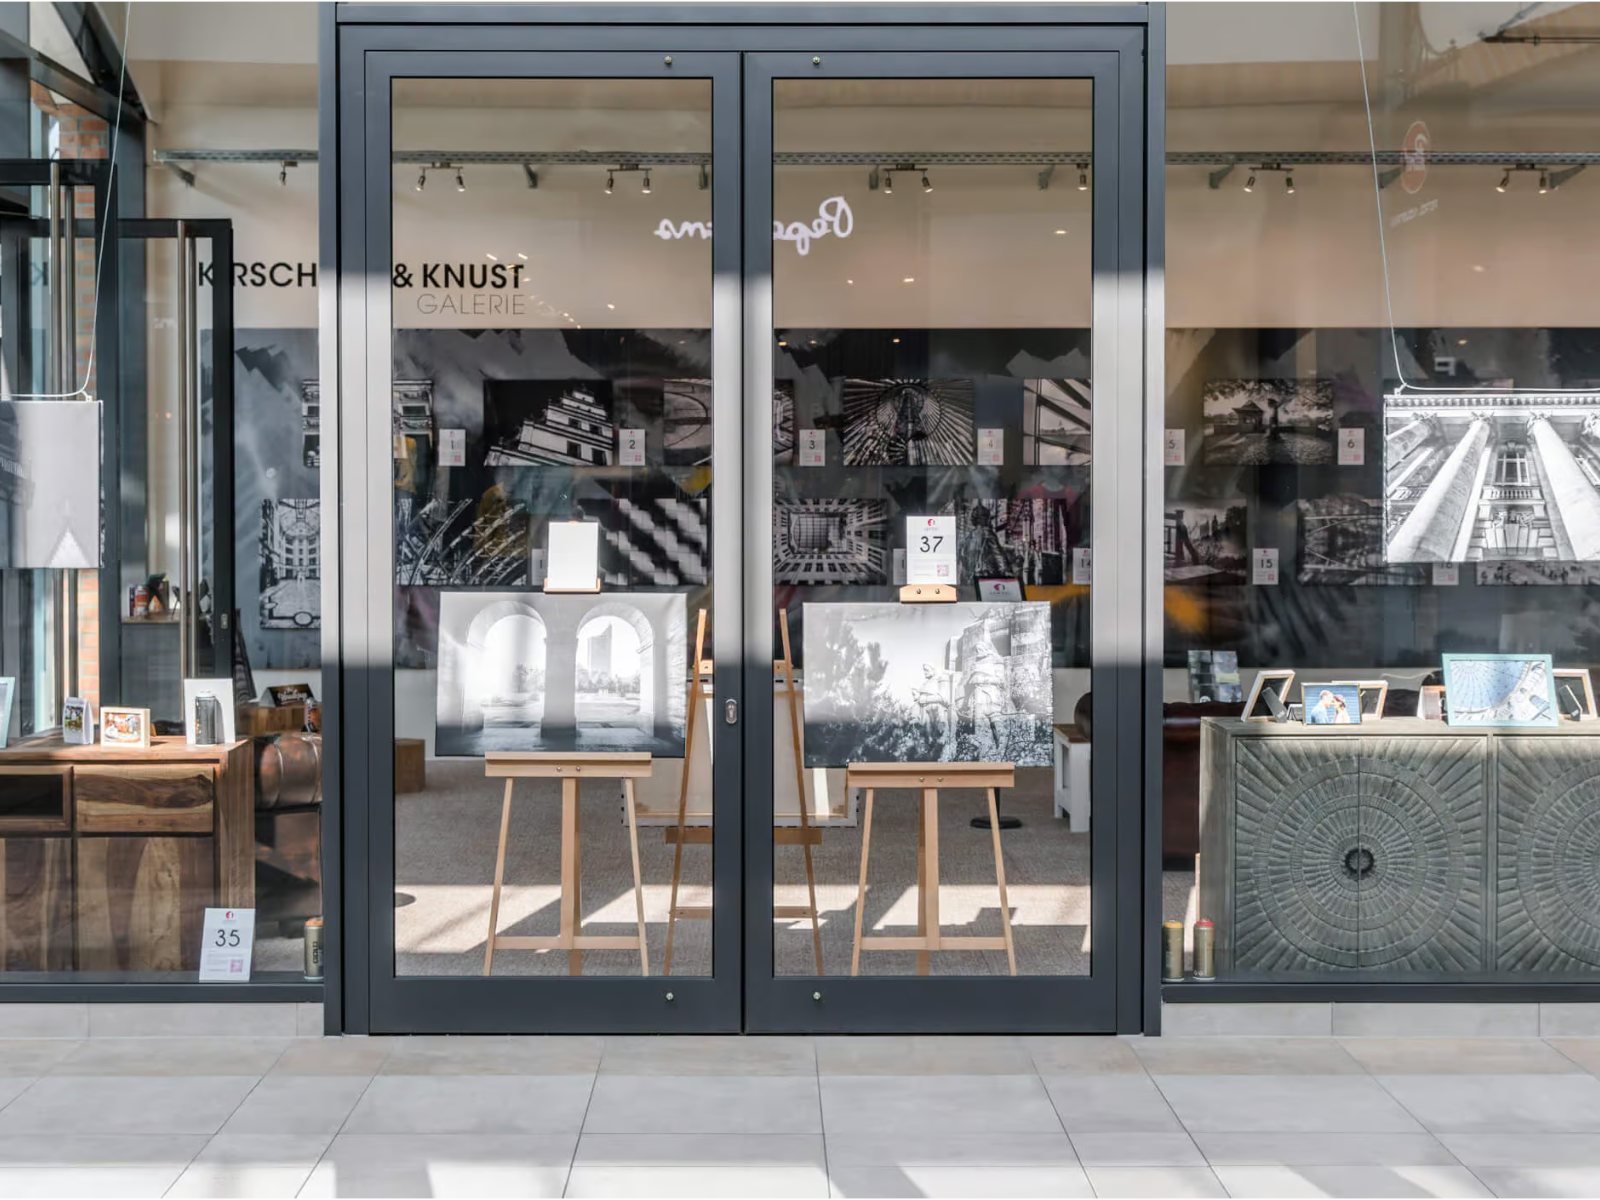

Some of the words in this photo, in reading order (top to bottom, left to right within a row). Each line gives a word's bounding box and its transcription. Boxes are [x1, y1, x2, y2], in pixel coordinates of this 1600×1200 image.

[198, 261, 317, 287] KRSCH
[392, 263, 414, 288] &
[422, 263, 525, 289] KNUST
[416, 293, 527, 315] GALERIE
[628, 439, 636, 450] 2
[808, 440, 816, 450] 3
[1346, 439, 1355, 449] 6
[919, 535, 944, 553] 37
[1260, 558, 1273, 569] 15
[215, 929, 241, 947] 35
